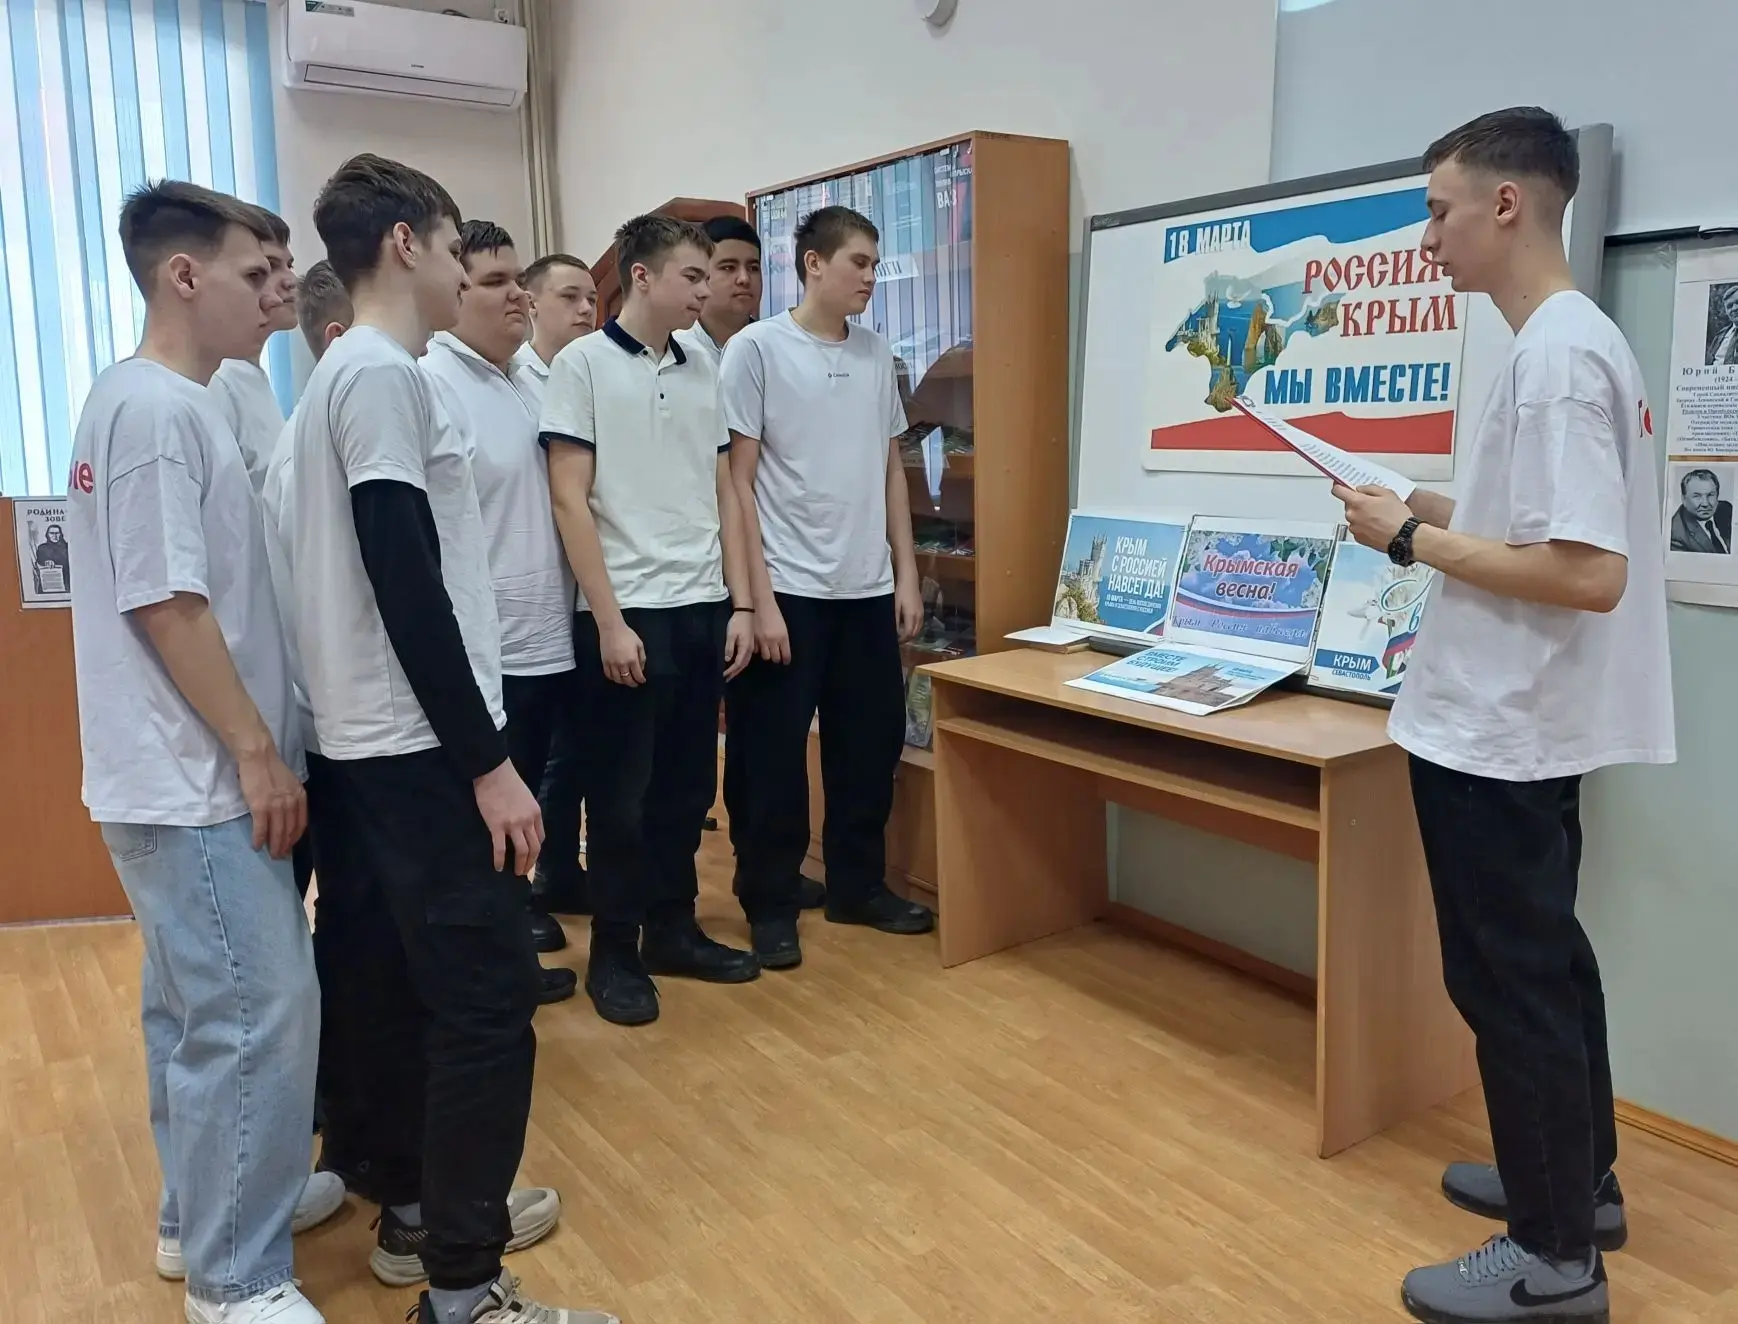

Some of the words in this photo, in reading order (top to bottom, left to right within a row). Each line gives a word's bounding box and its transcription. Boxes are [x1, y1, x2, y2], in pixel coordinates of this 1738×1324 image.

[1169, 229, 1190, 259] 18
[1195, 219, 1251, 255] МАРТА
[1302, 248, 1441, 294] РОССИЯ
[1340, 294, 1458, 337] КРЫМ
[1264, 368, 1312, 404] МЫ
[1325, 362, 1451, 404] ВМЕСТЕ!
[1115, 536, 1148, 556] КРЫМ
[1111, 555, 1119, 572] С
[1119, 556, 1168, 578] РОССИЕЙ
[1203, 554, 1299, 577] Крымская
[1107, 574, 1165, 599] НАВСЕГДА!
[1215, 581, 1277, 601] весна!
[1333, 654, 1372, 671] КРЫМ
[1331, 668, 1371, 681] СЕВАСТОПОЛЬ
